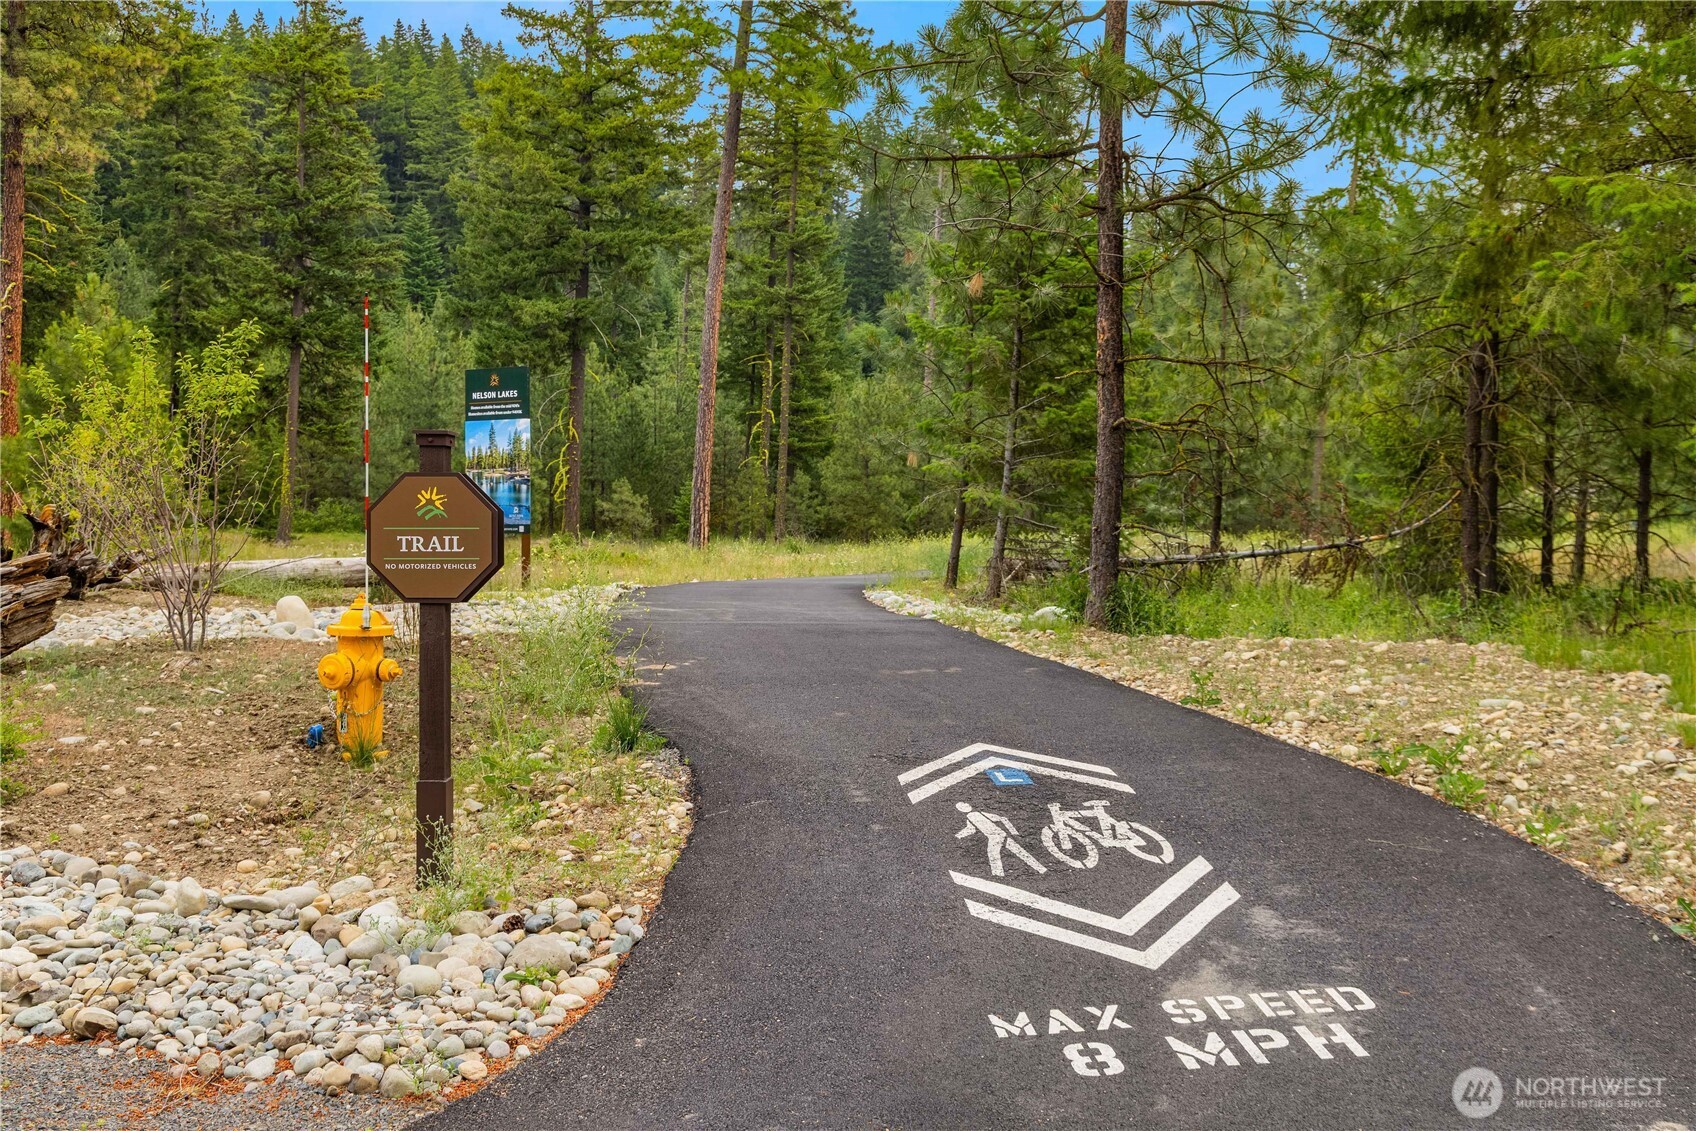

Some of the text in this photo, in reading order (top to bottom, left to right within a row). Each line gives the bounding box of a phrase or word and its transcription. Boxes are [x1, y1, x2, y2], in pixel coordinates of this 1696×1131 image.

[472, 390, 518, 400] NELSON LAKES
[396, 535, 465, 552] TRAIL
[987, 986, 1377, 1038] MAX SPEED
[1063, 1022, 1371, 1077] 8 MPH
